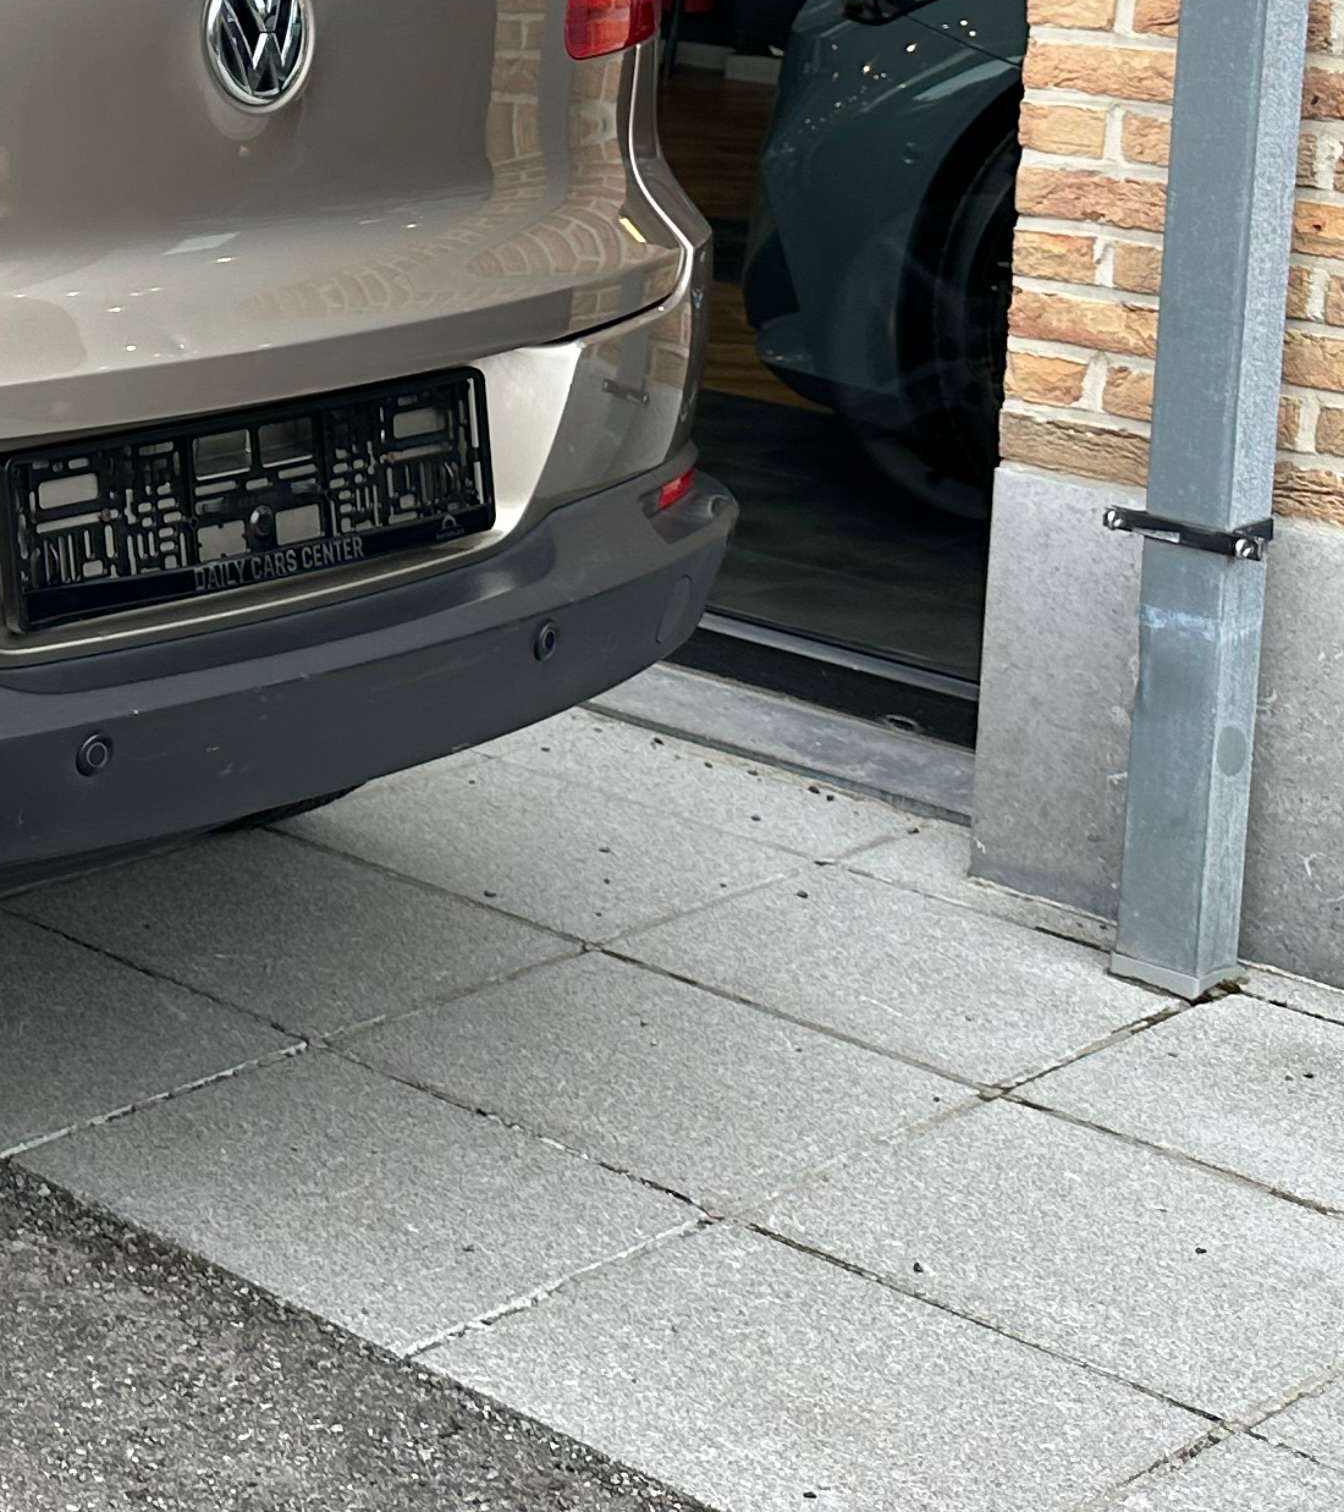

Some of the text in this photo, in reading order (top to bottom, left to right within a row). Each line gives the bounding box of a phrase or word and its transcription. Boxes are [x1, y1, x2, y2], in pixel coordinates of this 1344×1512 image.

[193, 536, 364, 592] DAILY CARS CENTER
